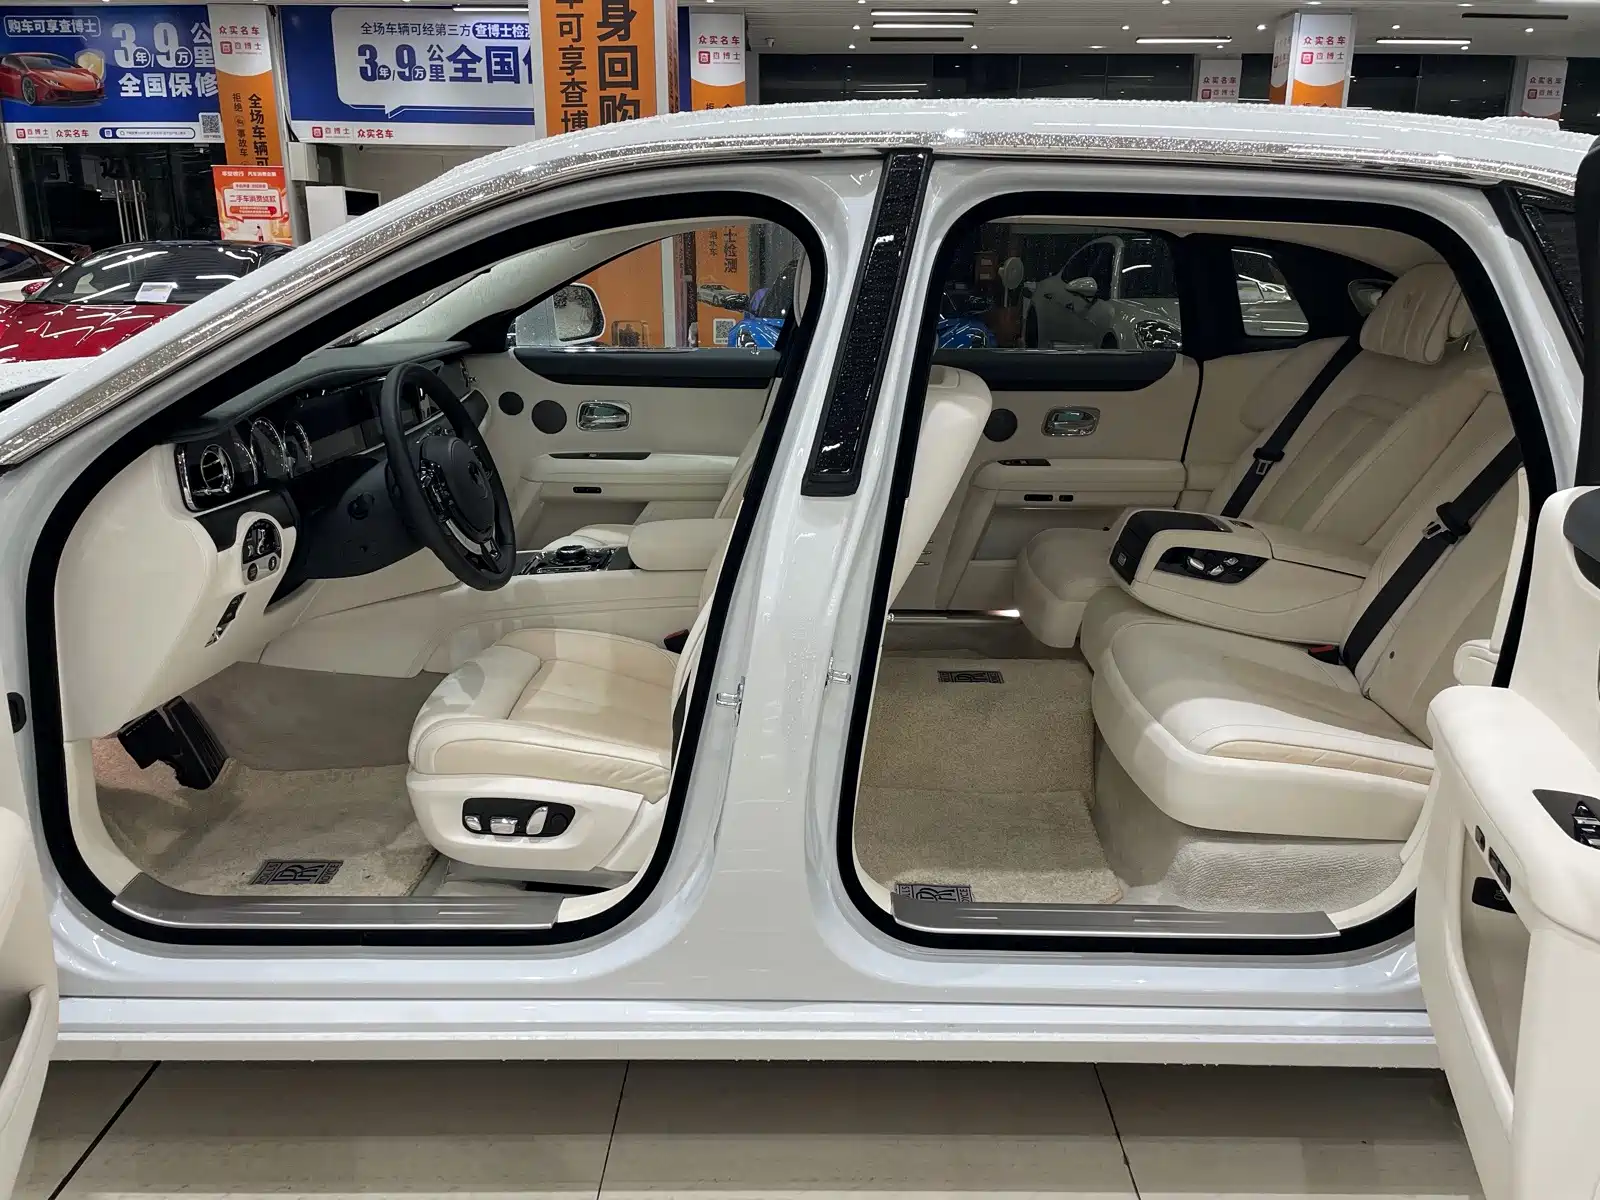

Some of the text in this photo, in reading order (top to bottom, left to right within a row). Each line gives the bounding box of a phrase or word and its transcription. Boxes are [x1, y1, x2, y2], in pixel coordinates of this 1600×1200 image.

[8, 19, 97, 33] 购车可享查博士
[219, 25, 261, 35] 众实名车
[698, 35, 740, 45] 众实名车
[1303, 36, 1346, 45] 众实名车
[597, 0, 640, 126] 身回购
[118, 72, 220, 98] 全国保修
[56, 129, 89, 138] 众实名车
[248, 93, 269, 166] 全场车辆可
[357, 128, 394, 139] 众实名车
[723, 225, 738, 273] 士检测
